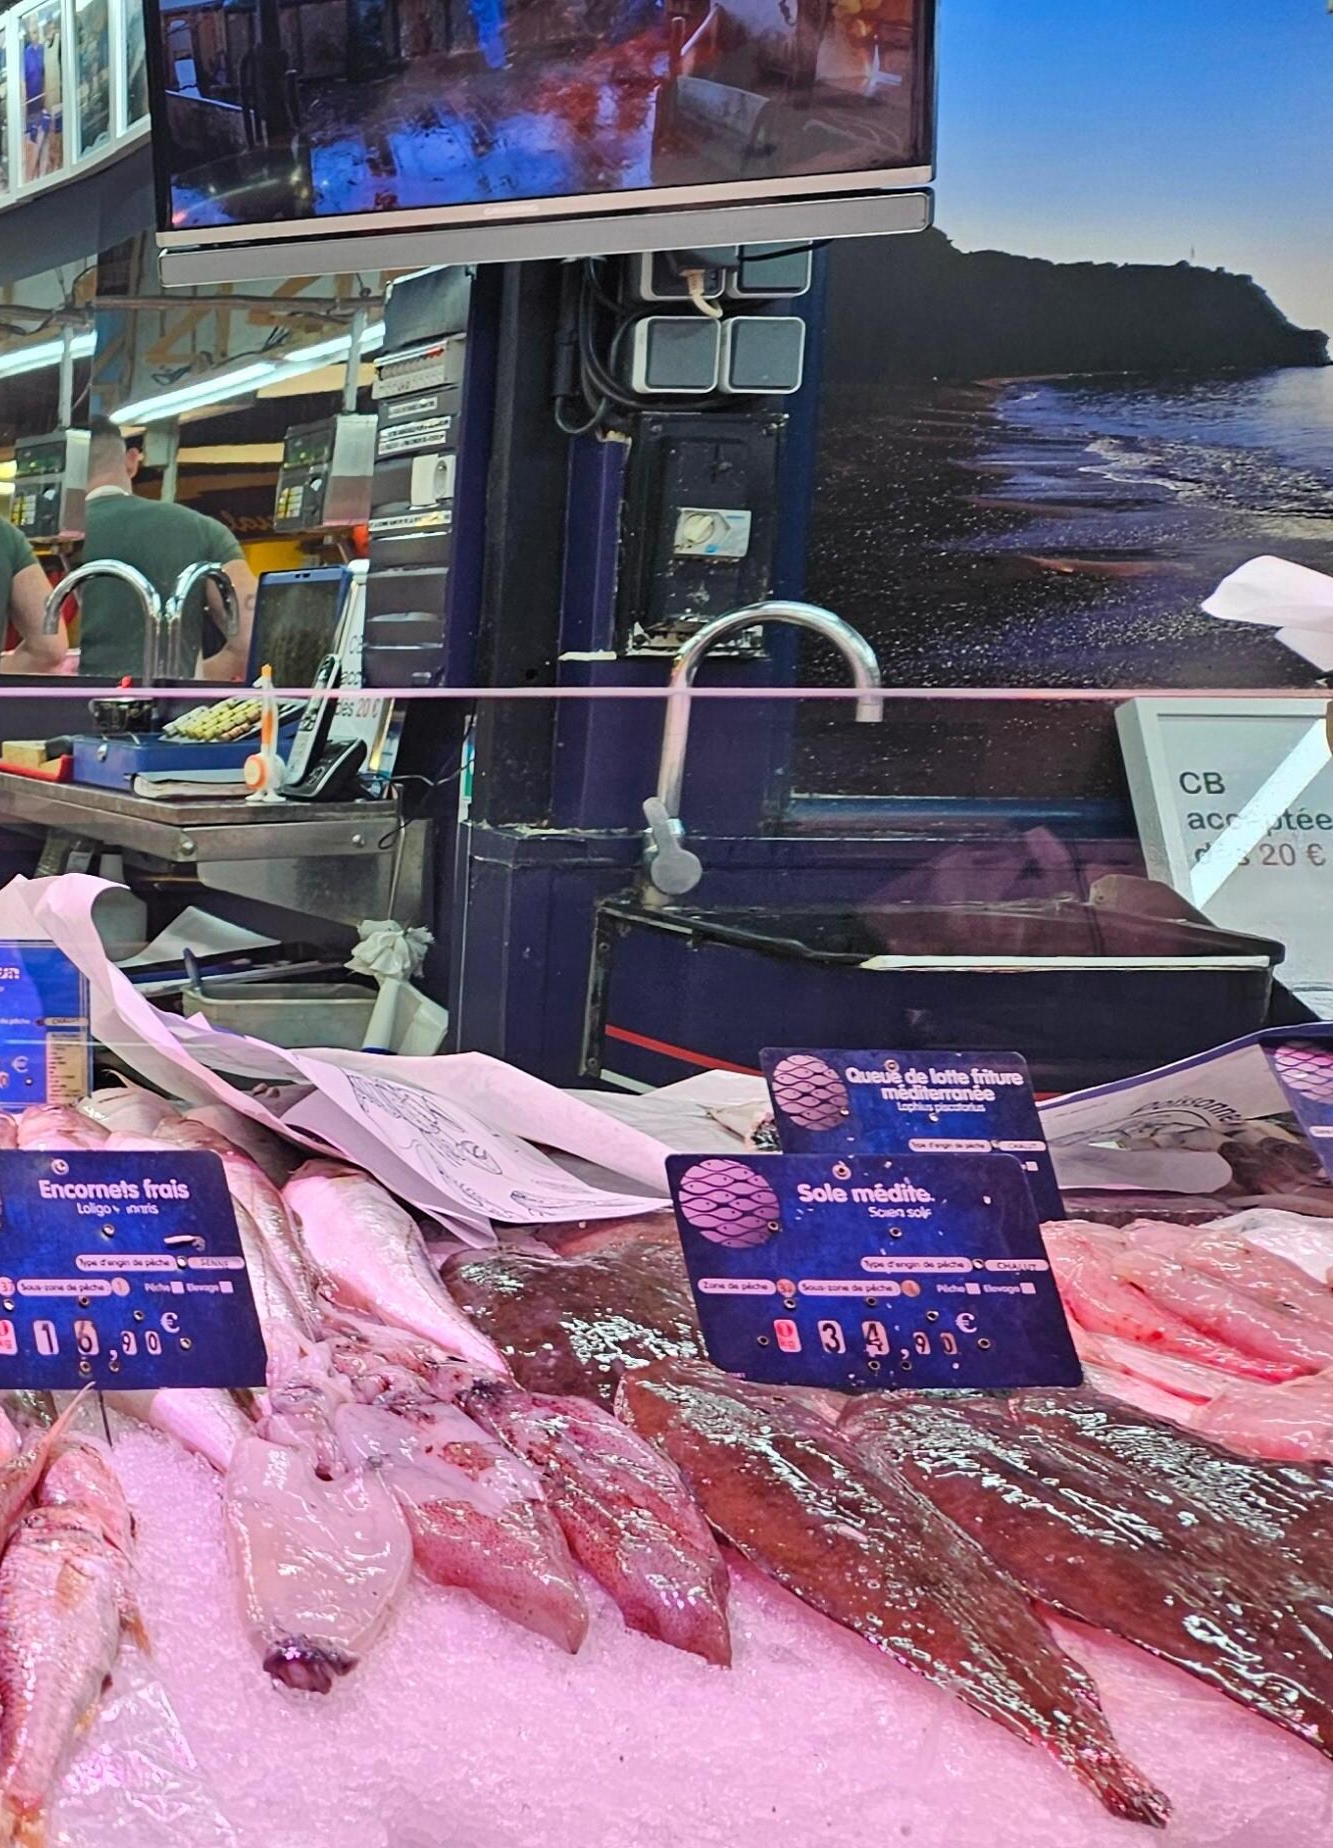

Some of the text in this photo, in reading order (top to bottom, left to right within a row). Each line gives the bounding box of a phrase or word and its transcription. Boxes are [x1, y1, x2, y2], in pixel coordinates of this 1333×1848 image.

[1179, 771, 1226, 795] CB
[1258, 842, 1296, 867] 20
[1306, 842, 1327, 867] €
[11, 1056, 29, 1073] €
[845, 1066, 1025, 1086] Queue de lotte friture
[881, 1084, 996, 1102] méditerranée
[38, 1178, 190, 1200] Encornets frais
[796, 1182, 849, 1204] Sole
[76, 1202, 112, 1218] Loligo
[160, 1312, 181, 1334] €
[954, 1312, 978, 1334] €
